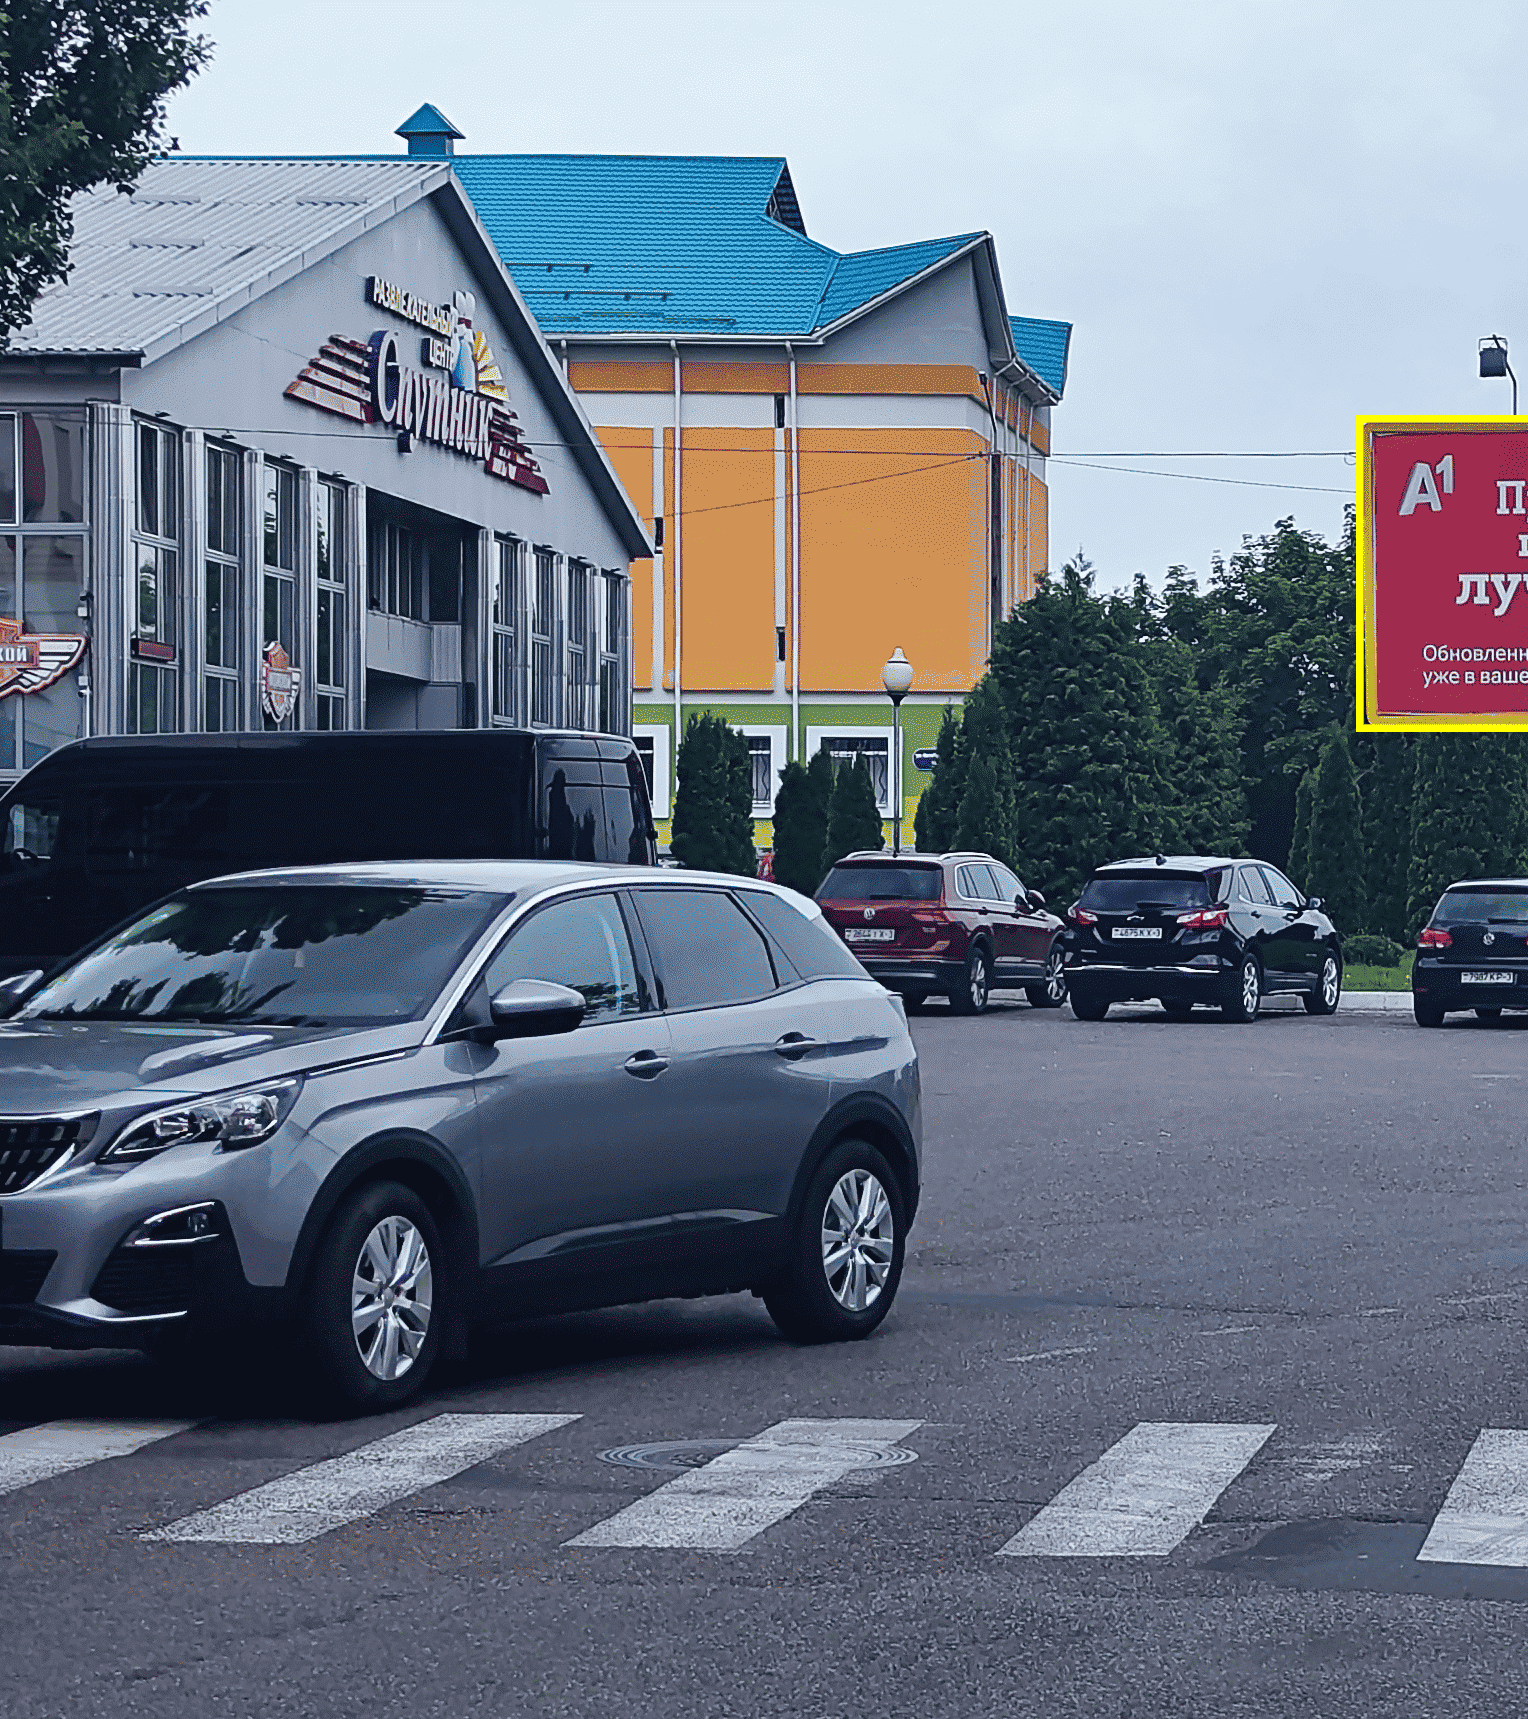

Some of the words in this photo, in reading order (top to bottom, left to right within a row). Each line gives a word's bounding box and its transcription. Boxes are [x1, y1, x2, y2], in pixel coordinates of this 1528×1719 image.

[1398, 454, 1454, 516] A1
[1422, 669, 1460, 689] уже
[1464, 670, 1476, 685] в
